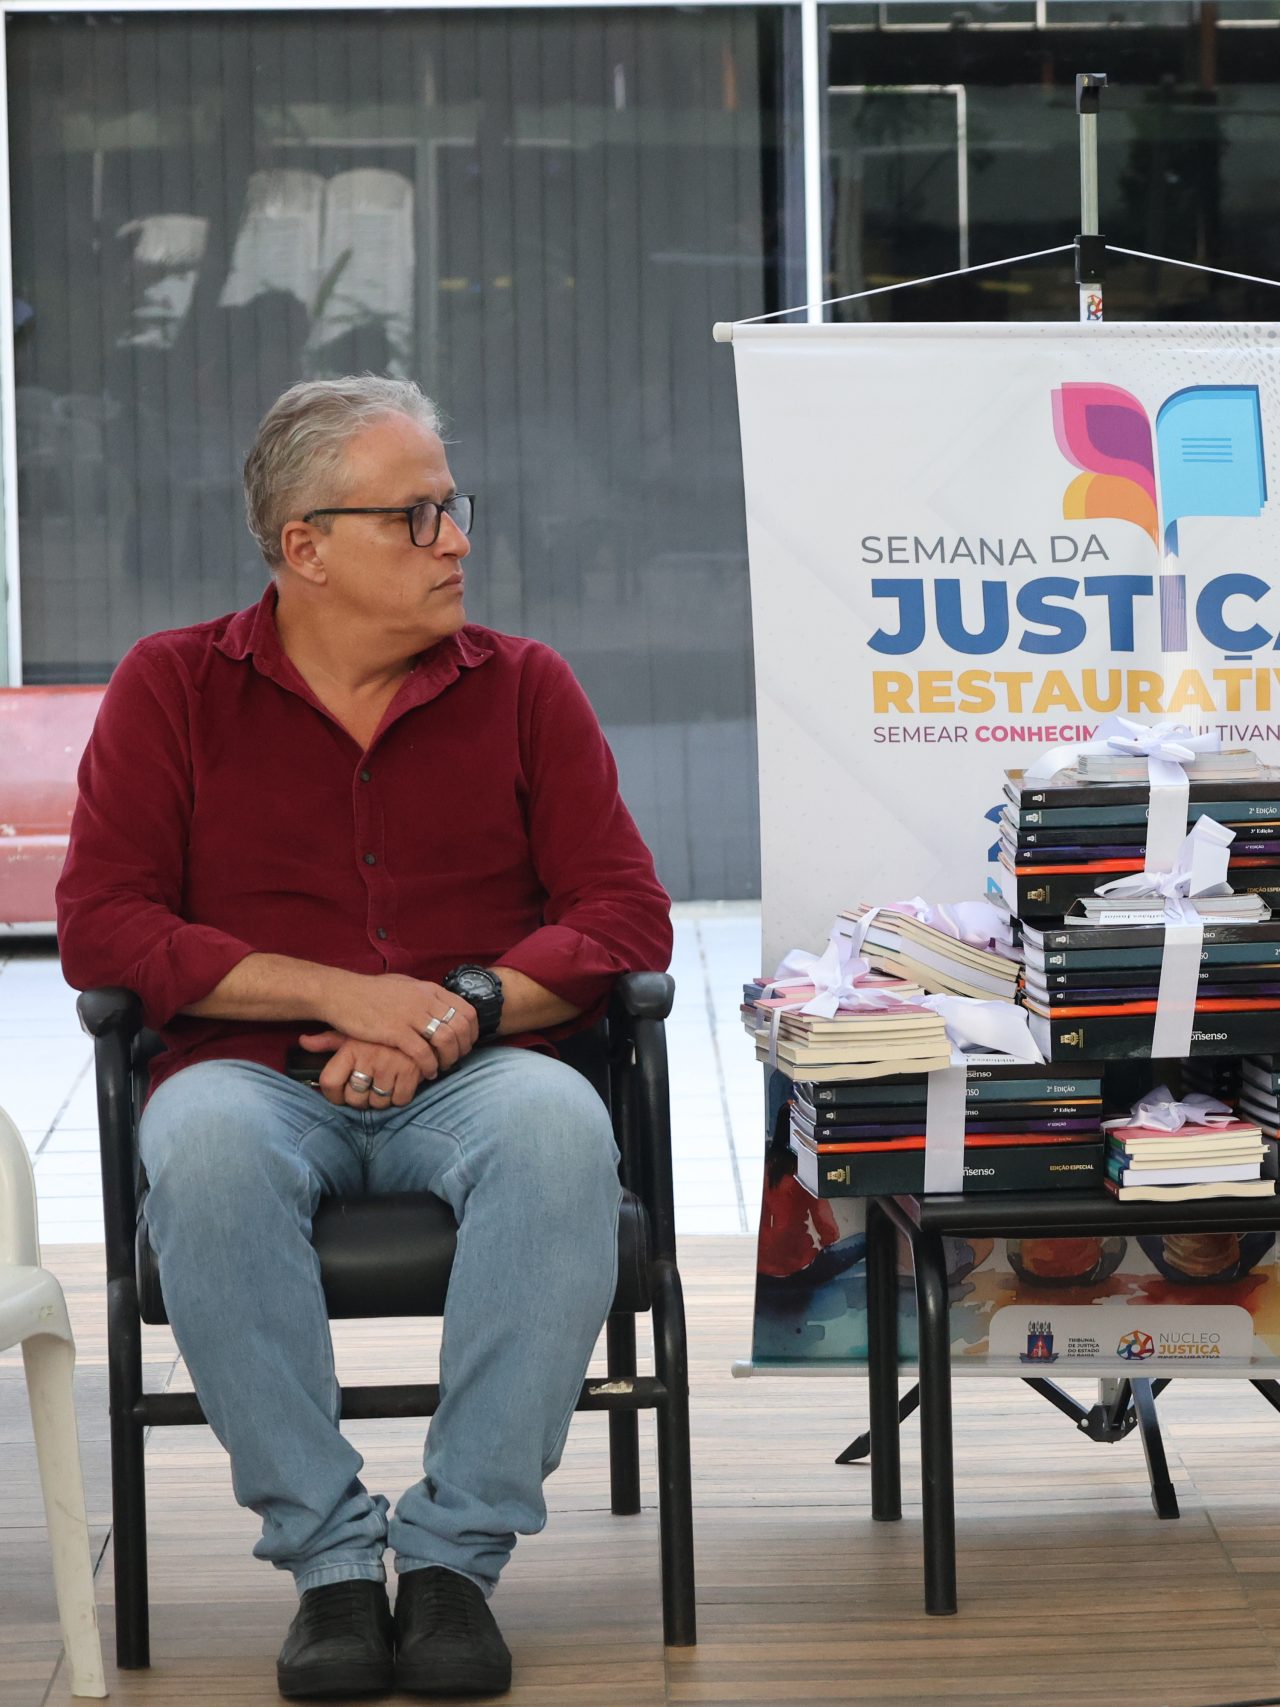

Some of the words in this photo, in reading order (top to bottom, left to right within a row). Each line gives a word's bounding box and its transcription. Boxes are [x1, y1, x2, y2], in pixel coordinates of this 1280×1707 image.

[861, 536, 1037, 567] SEMANA
[1050, 534, 1110, 563] DA
[873, 725, 968, 743] SEMEAR
[975, 724, 1099, 743] CONHECIM
[1191, 1032, 1228, 1041] onsenso
[1159, 1345, 1221, 1355] JUSTIÇA
